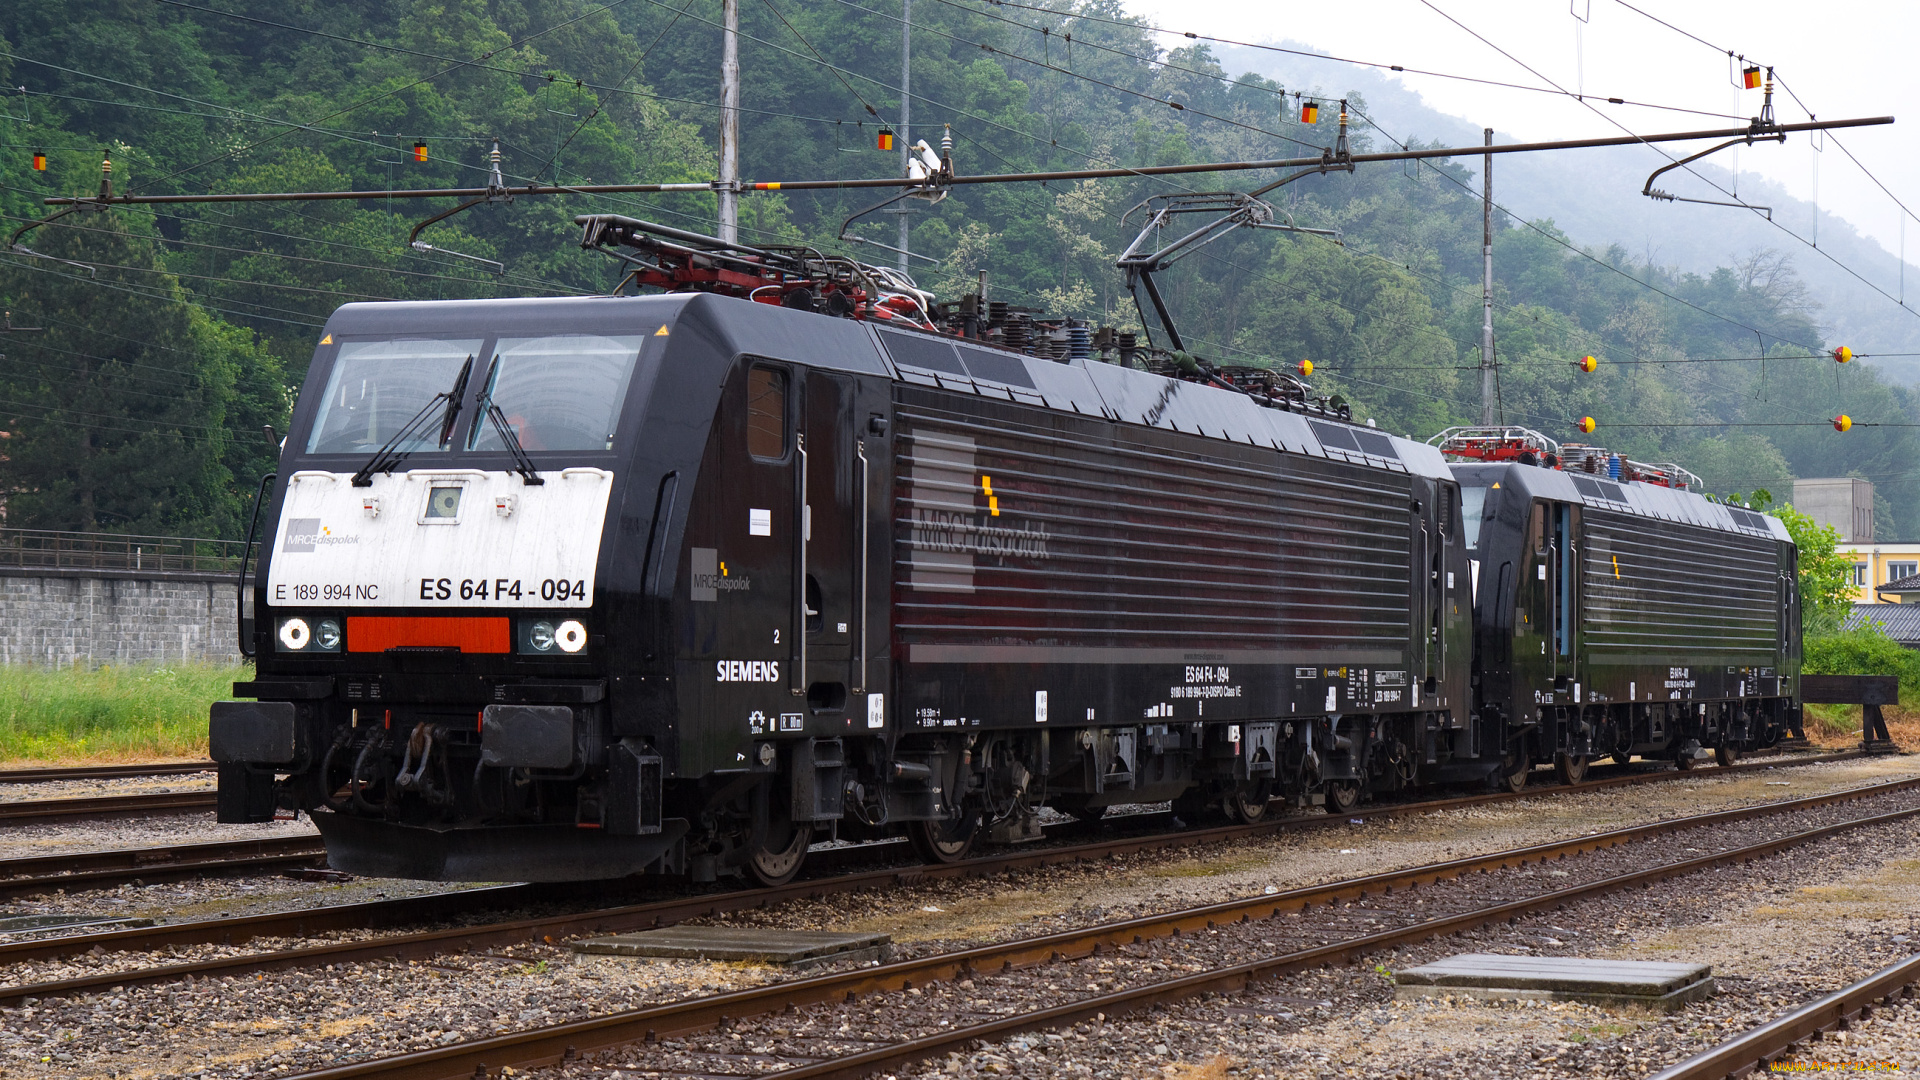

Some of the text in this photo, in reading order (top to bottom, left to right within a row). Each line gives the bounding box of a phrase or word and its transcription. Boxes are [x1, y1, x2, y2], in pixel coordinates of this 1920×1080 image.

[276, 584, 379, 600] E 189 994 NC
[420, 579, 451, 600] ES
[460, 579, 489, 601] 64
[495, 579, 522, 601] F4
[541, 579, 586, 601] 094
[773, 629, 780, 644] 2
[717, 660, 779, 682] SIEMENS
[1185, 666, 1194, 682] ES
[1195, 666, 1204, 682] 64
[1205, 666, 1213, 682] F4
[1217, 666, 1229, 682] 094
